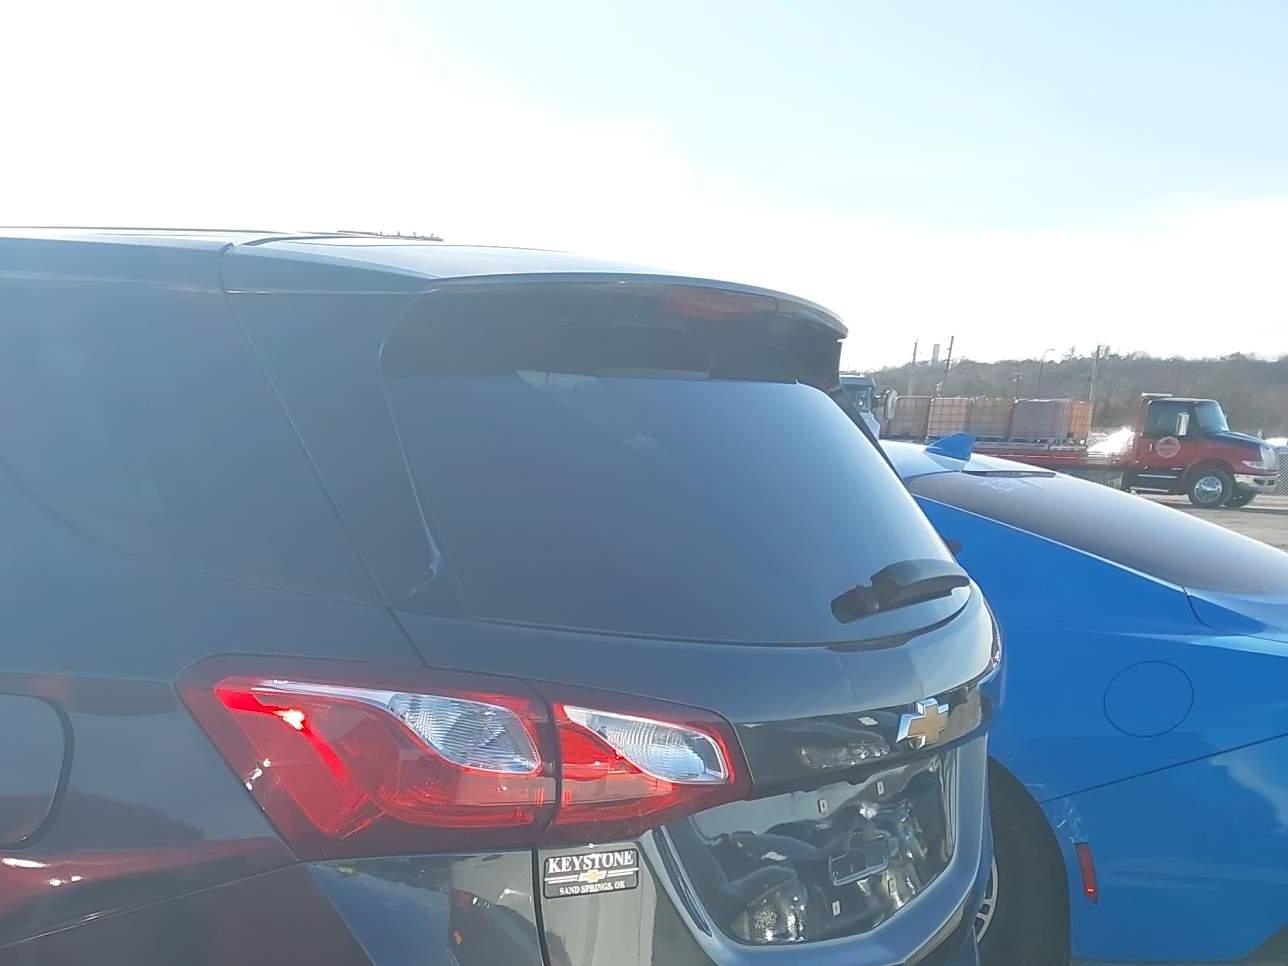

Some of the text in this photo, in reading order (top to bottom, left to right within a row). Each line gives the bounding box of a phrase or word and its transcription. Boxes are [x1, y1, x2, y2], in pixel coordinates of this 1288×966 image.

[547, 850, 634, 874] KEYSTONE
[559, 886, 580, 895] SAND
[614, 880, 626, 889] OK
